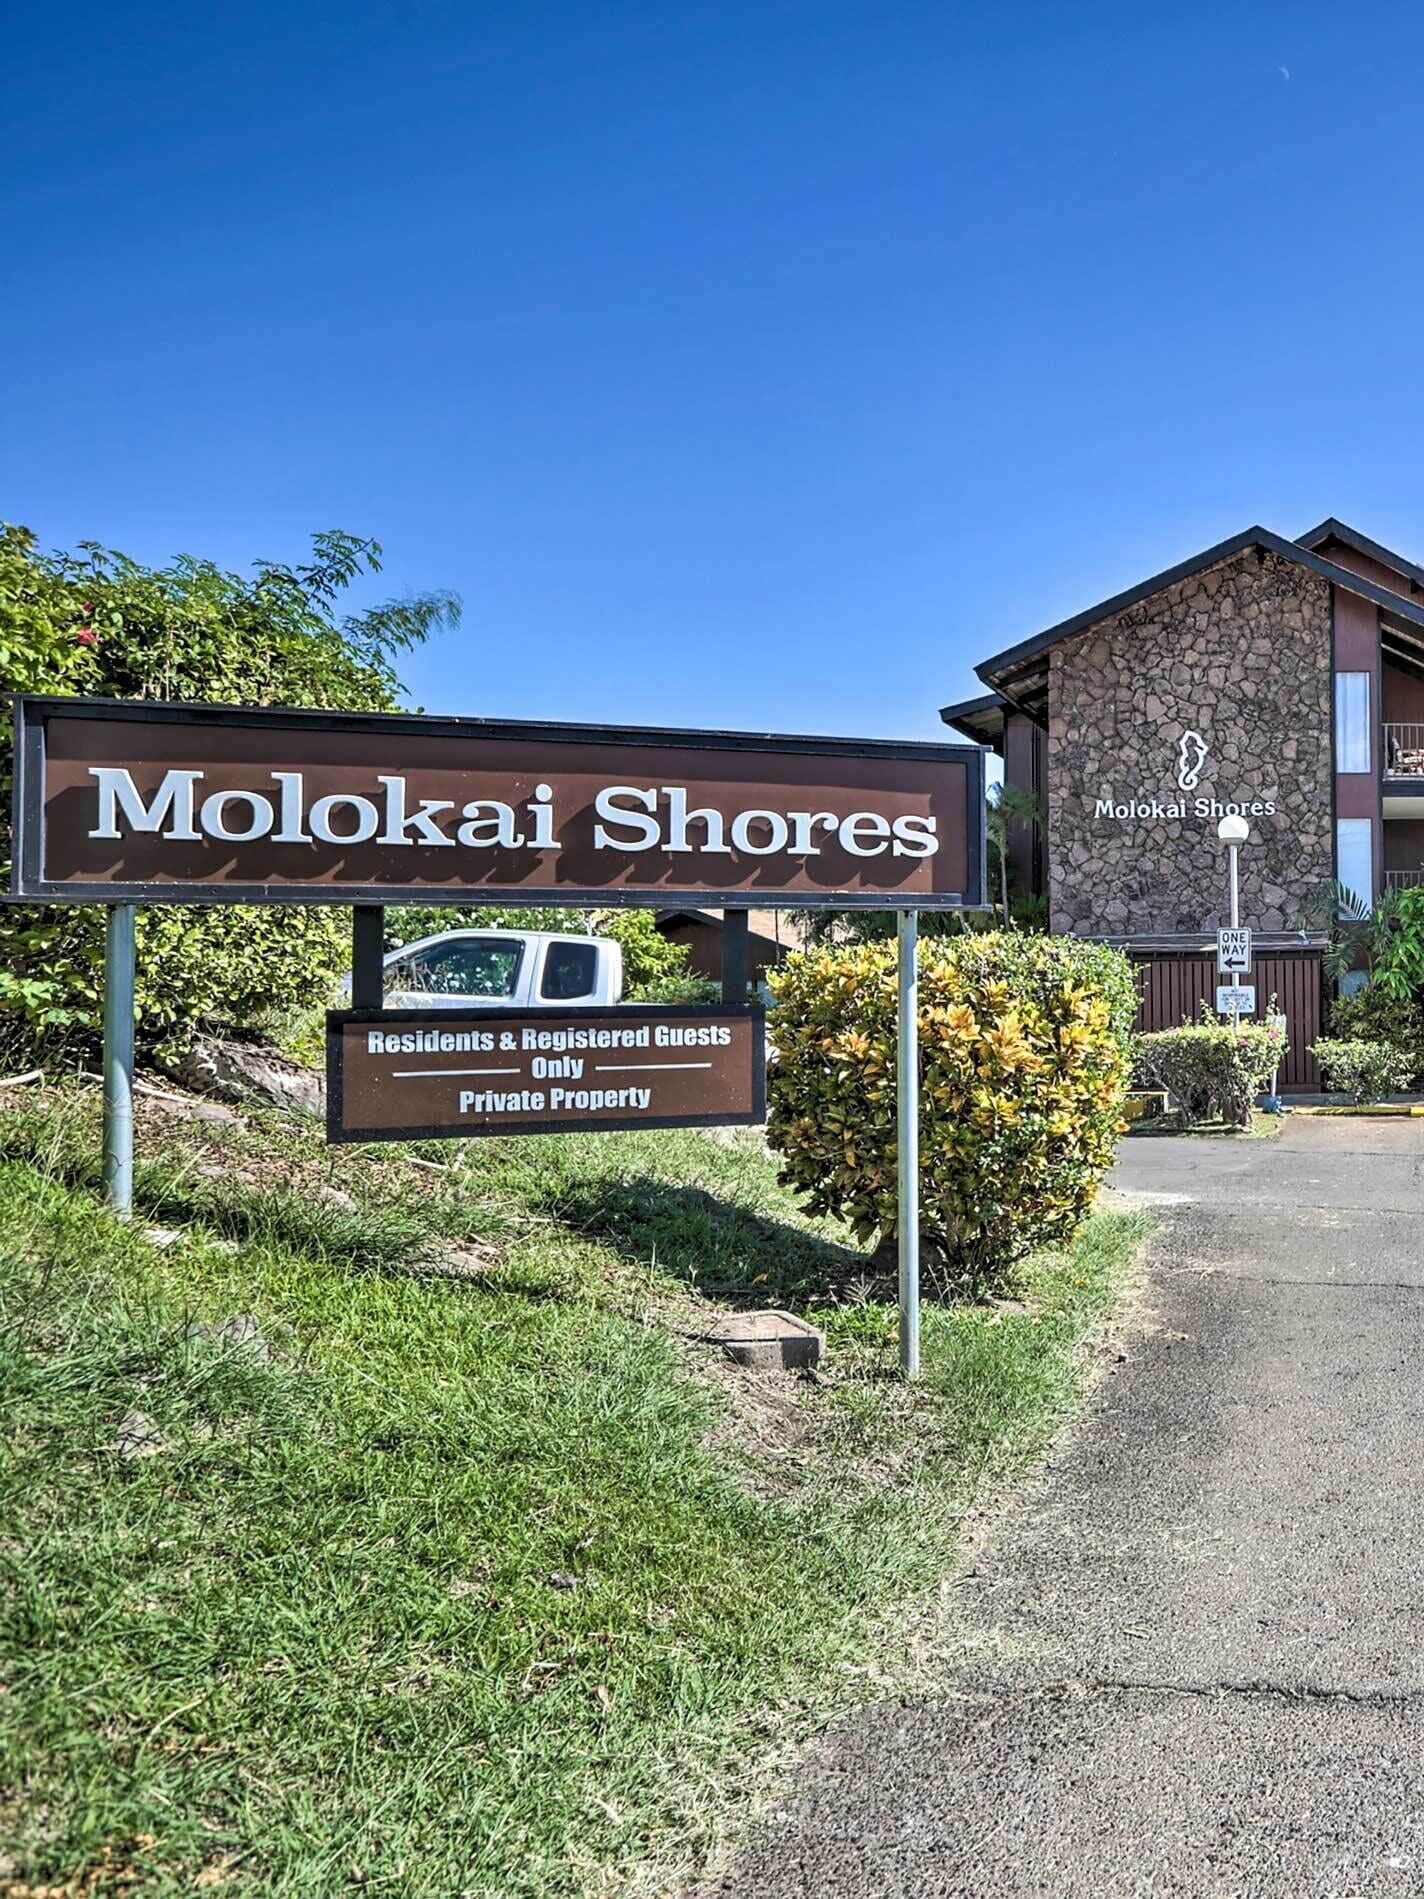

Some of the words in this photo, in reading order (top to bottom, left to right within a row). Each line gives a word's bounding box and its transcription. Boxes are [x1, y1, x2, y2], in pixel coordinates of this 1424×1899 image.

[88, 767, 562, 850] Molokai
[594, 786, 940, 858] Shores
[1094, 799, 1186, 819] Molokai
[1194, 798, 1276, 818] Shores
[1221, 944, 1247, 955] WAY
[1222, 932, 1246, 943] ONE
[367, 1029, 495, 1054] Residents
[499, 1031, 517, 1051] &
[521, 1026, 650, 1052] Registered
[654, 1025, 732, 1047] Guests
[531, 1056, 584, 1080] Only
[459, 1090, 545, 1113] Private
[549, 1087, 651, 1111] Property
